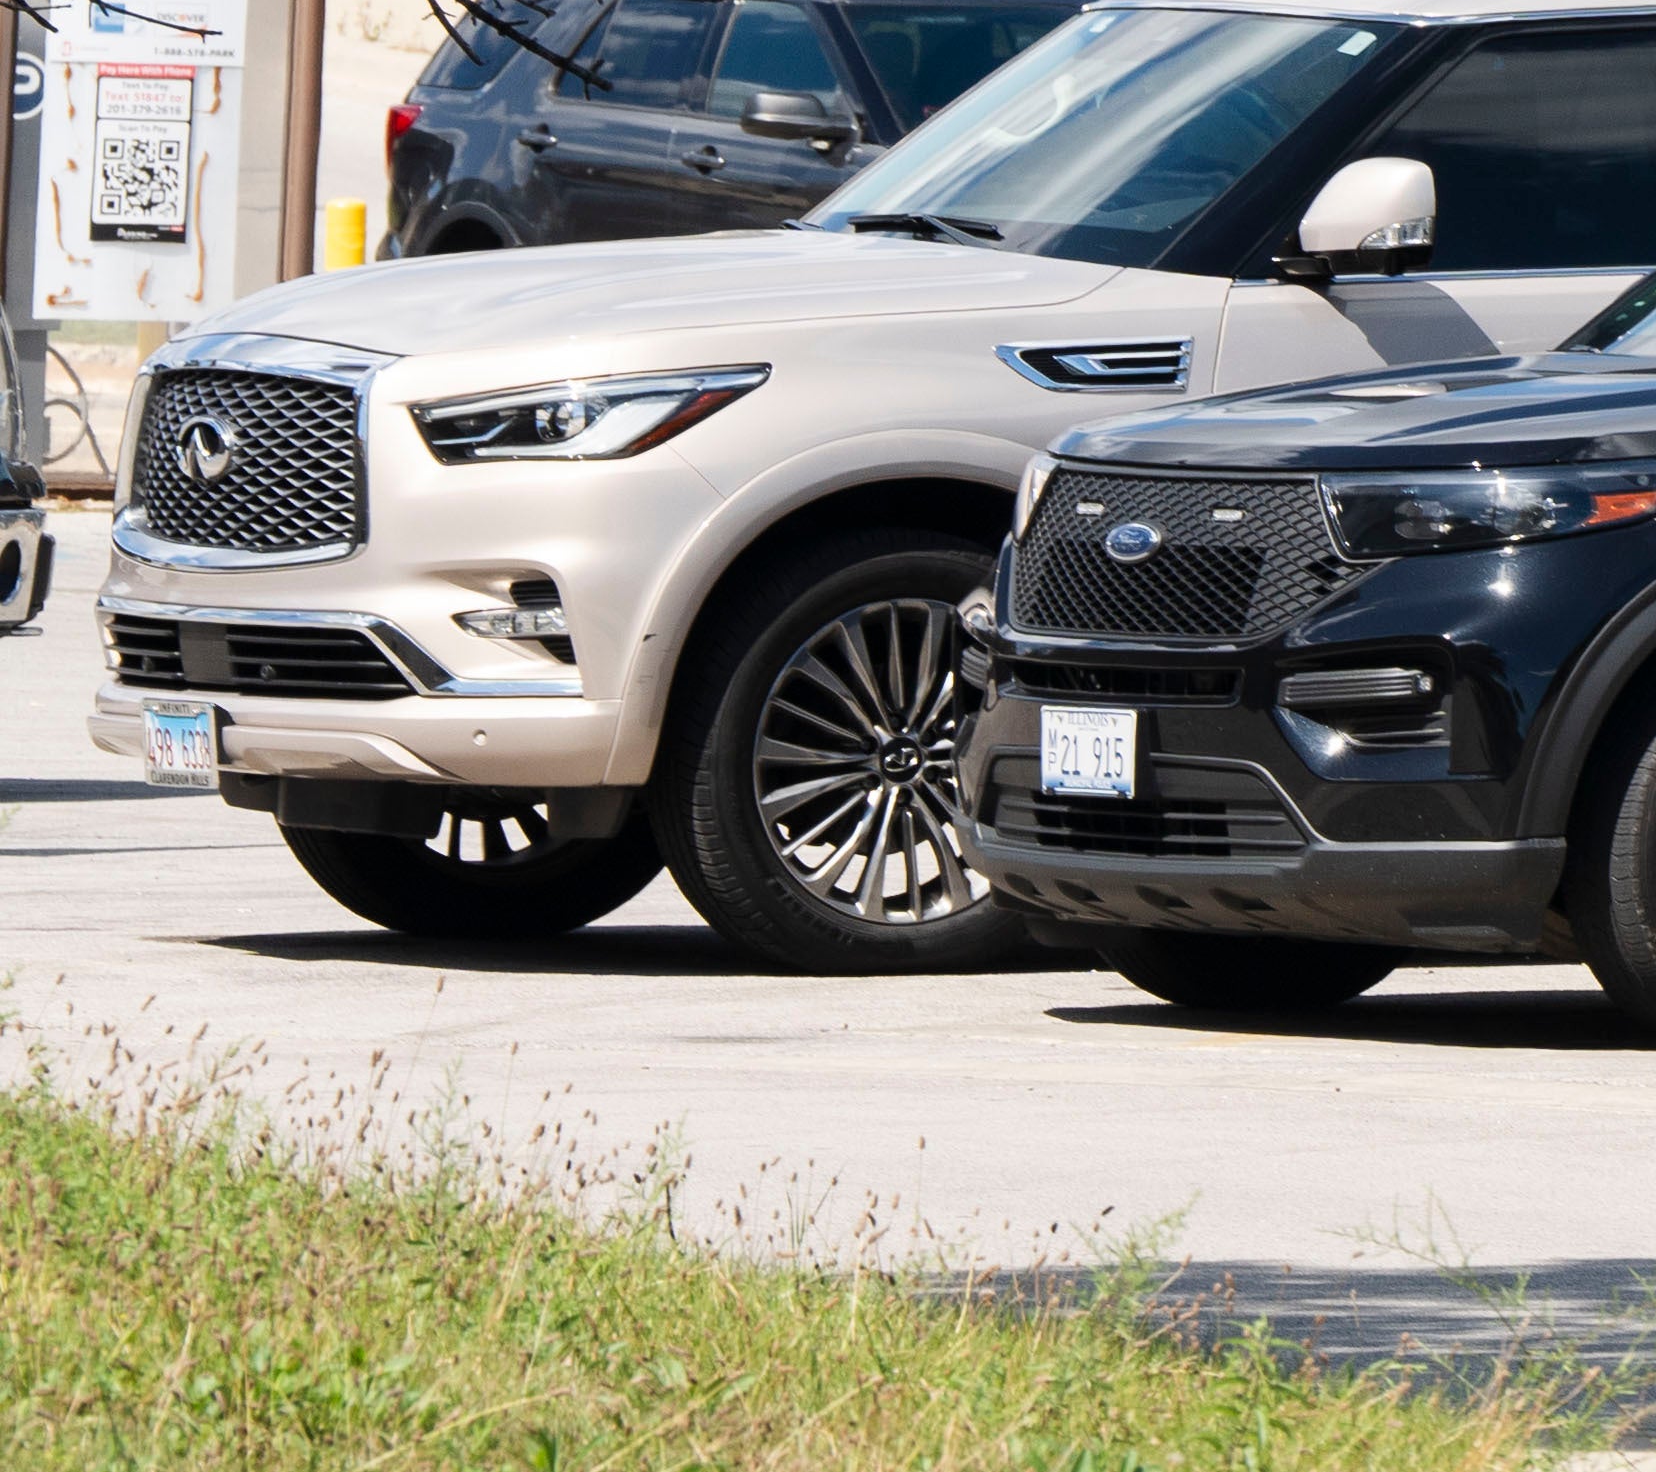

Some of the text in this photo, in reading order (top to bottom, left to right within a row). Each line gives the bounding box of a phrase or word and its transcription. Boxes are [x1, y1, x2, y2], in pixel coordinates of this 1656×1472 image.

[157, 12, 205, 23] DISCOVER
[105, 91, 129, 102] Text
[160, 703, 191, 715] INFINITI
[1067, 711, 1109, 727] ILLINOIS
[1061, 734, 1124, 778] 21 915
